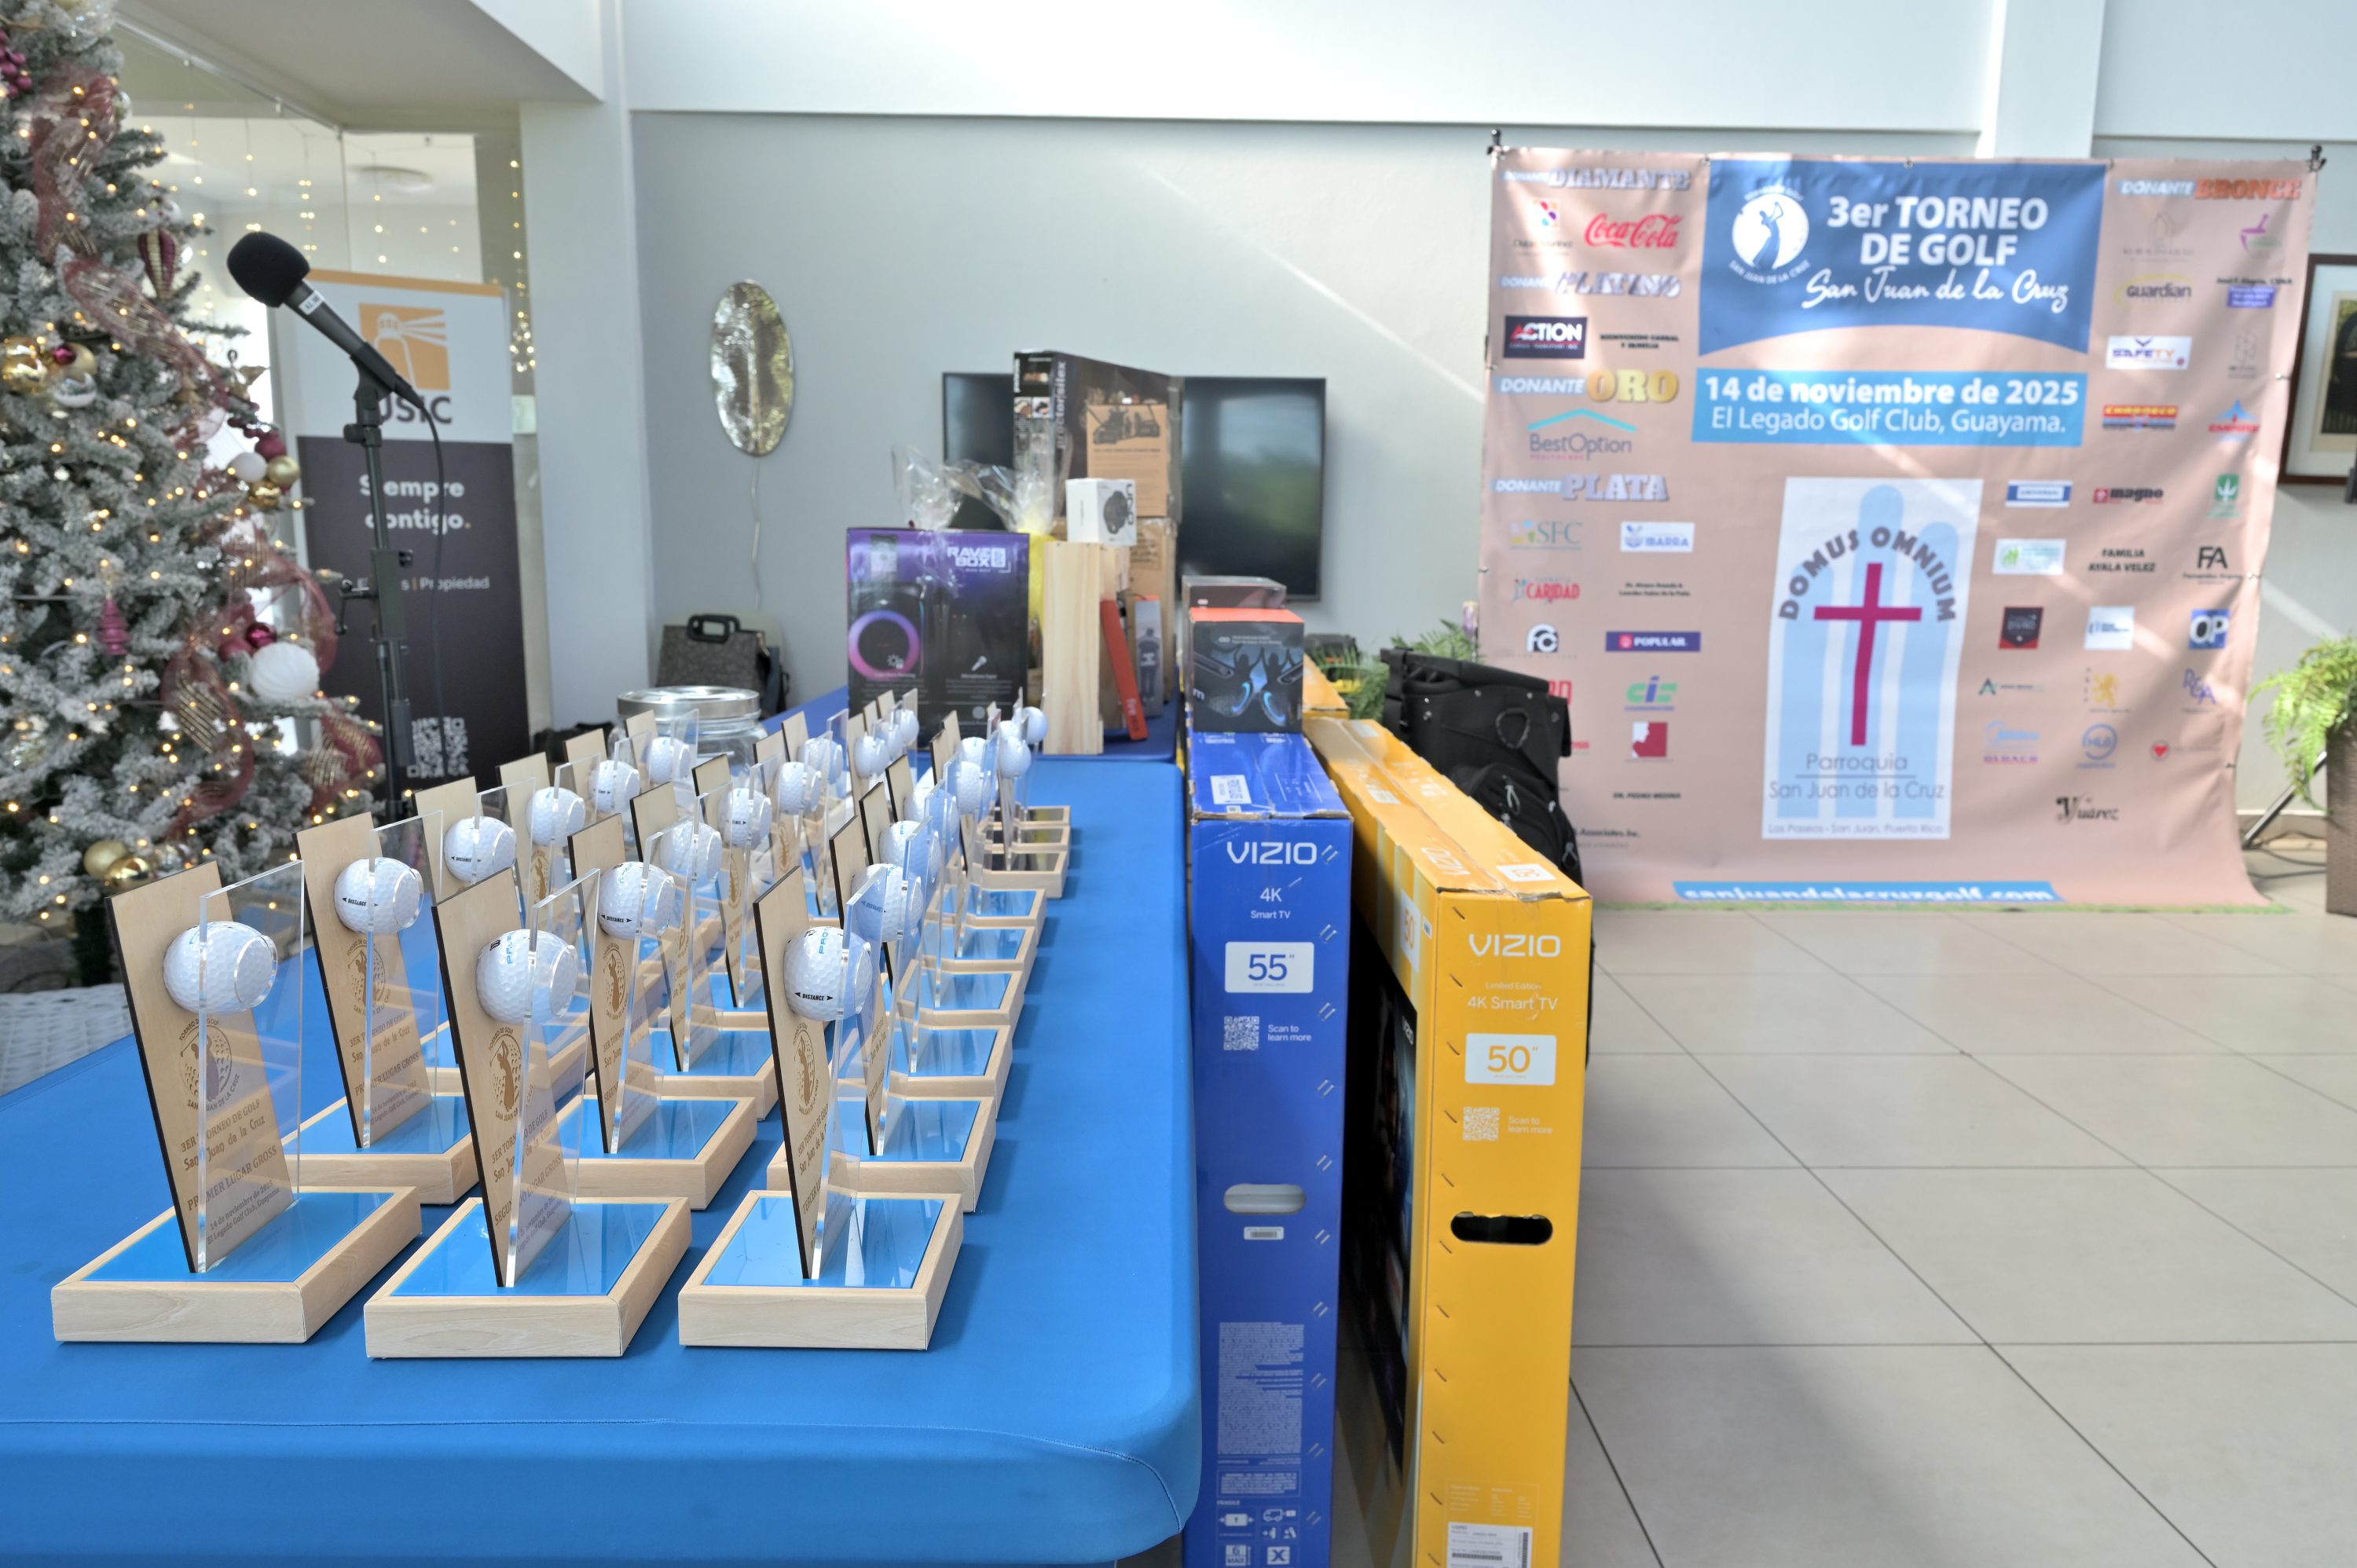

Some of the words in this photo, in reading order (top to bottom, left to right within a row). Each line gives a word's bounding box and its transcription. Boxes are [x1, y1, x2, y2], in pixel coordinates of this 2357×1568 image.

[1548, 169, 1690, 190] DIAMANTE
[2121, 181, 2195, 197] DONANTE
[2194, 178, 2303, 200] BRONCE
[1827, 196, 1889, 228] 3er
[1894, 196, 2049, 230] TORNEO
[1860, 233, 1911, 266] DE
[1918, 234, 2019, 266] GOLF
[1556, 272, 1681, 298] PLATINO
[1802, 269, 1858, 309] San
[1864, 265, 1930, 303] Juan
[1934, 268, 1967, 300] de
[1971, 268, 2004, 300] la
[2011, 269, 2069, 313] Cruz
[1510, 323, 1582, 342] ACTION
[1501, 378, 1585, 394] DONANTE
[1586, 369, 1679, 403] ORO
[1706, 376, 1739, 401] 14
[1747, 376, 1783, 403] de
[1789, 377, 1956, 405] noviembre
[1969, 379, 2000, 405] de
[2005, 380, 2079, 405] 2025
[1712, 406, 1731, 430] El
[1739, 407, 1826, 437] Legado
[1831, 408, 1882, 432] Golf
[1884, 408, 1945, 435] Club,
[1950, 409, 2066, 439] Guayama.
[1529, 433, 1633, 460] BestOption
[359, 474, 465, 503] Sempe
[1495, 480, 1563, 493] DONANTE
[1563, 474, 1670, 501] PLATA
[2110, 488, 2164, 503] magno
[1535, 521, 1583, 544] SFC
[2102, 548, 2145, 559] FAMILIA
[1778, 529, 1860, 621] DOMUS
[1871, 526, 1956, 622] OMNIUM
[2124, 562, 2156, 573] VELEZ
[1526, 583, 1580, 600] CARIDAD
[1633, 637, 1686, 647] POPULAR
[1806, 753, 1908, 775] Parroquia
[1769, 781, 1802, 800] San
[1807, 781, 1849, 800] Juan
[1854, 780, 1879, 799] de
[1883, 781, 1900, 799] la
[1905, 782, 1945, 800] Cruz
[1768, 824, 1785, 834] Los
[1787, 824, 1824, 834] Paseos
[1831, 824, 1851, 834] San
[1884, 824, 1918, 834] Puerto
[1920, 824, 1943, 834] Rico
[1227, 841, 1318, 865] VIZIO
[347, 898, 367, 907] DISTANCE
[1259, 888, 1282, 903] 4K
[1251, 910, 1277, 919] Smart
[1278, 910, 1291, 919] TV
[1468, 933, 1560, 957] VIZIO
[1485, 982, 1514, 991] Limited
[1515, 982, 1541, 991] Edition
[1468, 996, 1487, 1009] 4K
[1490, 996, 1534, 1010] Smart
[1539, 998, 1558, 1010] TV
[179, 1020, 195, 1041] TORNEO
[349, 1036, 361, 1047] 3ER
[387, 1021, 394, 1030] DE
[394, 1012, 406, 1025] GOLF
[1267, 1024, 1288, 1033] Scan
[1290, 1024, 1299, 1033] to
[1267, 1033, 1288, 1042] learn
[351, 1052, 363, 1063] San
[383, 1037, 390, 1047] de
[398, 1026, 410, 1038] Cruz
[382, 1064, 401, 1082] LUGAR
[401, 1052, 420, 1069] GROSS
[188, 1100, 198, 1110] SAN
[218, 1098, 225, 1107] DE
[224, 1092, 231, 1101] LA
[181, 1136, 196, 1152] 3ER
[199, 1118, 232, 1140] ORNEO
[232, 1110, 243, 1123] DE
[243, 1098, 260, 1116] GOLF
[1508, 1116, 1530, 1126] Scan
[1531, 1116, 1540, 1126] to
[1508, 1125, 1529, 1134] learn
[1530, 1126, 1553, 1134] more
[184, 1155, 198, 1171] San
[206, 1142, 225, 1162] Juan
[228, 1134, 237, 1145] de
[240, 1127, 247, 1138] la
[250, 1116, 266, 1130] Cruz
[491, 1149, 502, 1163] 3ER
[502, 1129, 528, 1152] TORNO
[529, 1121, 536, 1134] DE
[536, 1108, 548, 1126] GOLF
[493, 1168, 504, 1182] San
[526, 1144, 533, 1157] de
[527, 1172, 545, 1196] LUGAR
[545, 1154, 562, 1178] GROSS
[187, 1181, 225, 1211] PRMER
[225, 1163, 252, 1188] LUGAR
[253, 1145, 277, 1168] GROSS
[210, 1220, 218, 1230] 14
[218, 1216, 225, 1225] de
[225, 1196, 253, 1220] noviembre
[253, 1190, 260, 1199] de
[260, 1180, 273, 1194] 2025
[802, 1187, 816, 1215] TERCER
[214, 1223, 233, 1240] Legado
[233, 1213, 244, 1225] Golf
[257, 1188, 280, 1207] Guayama
